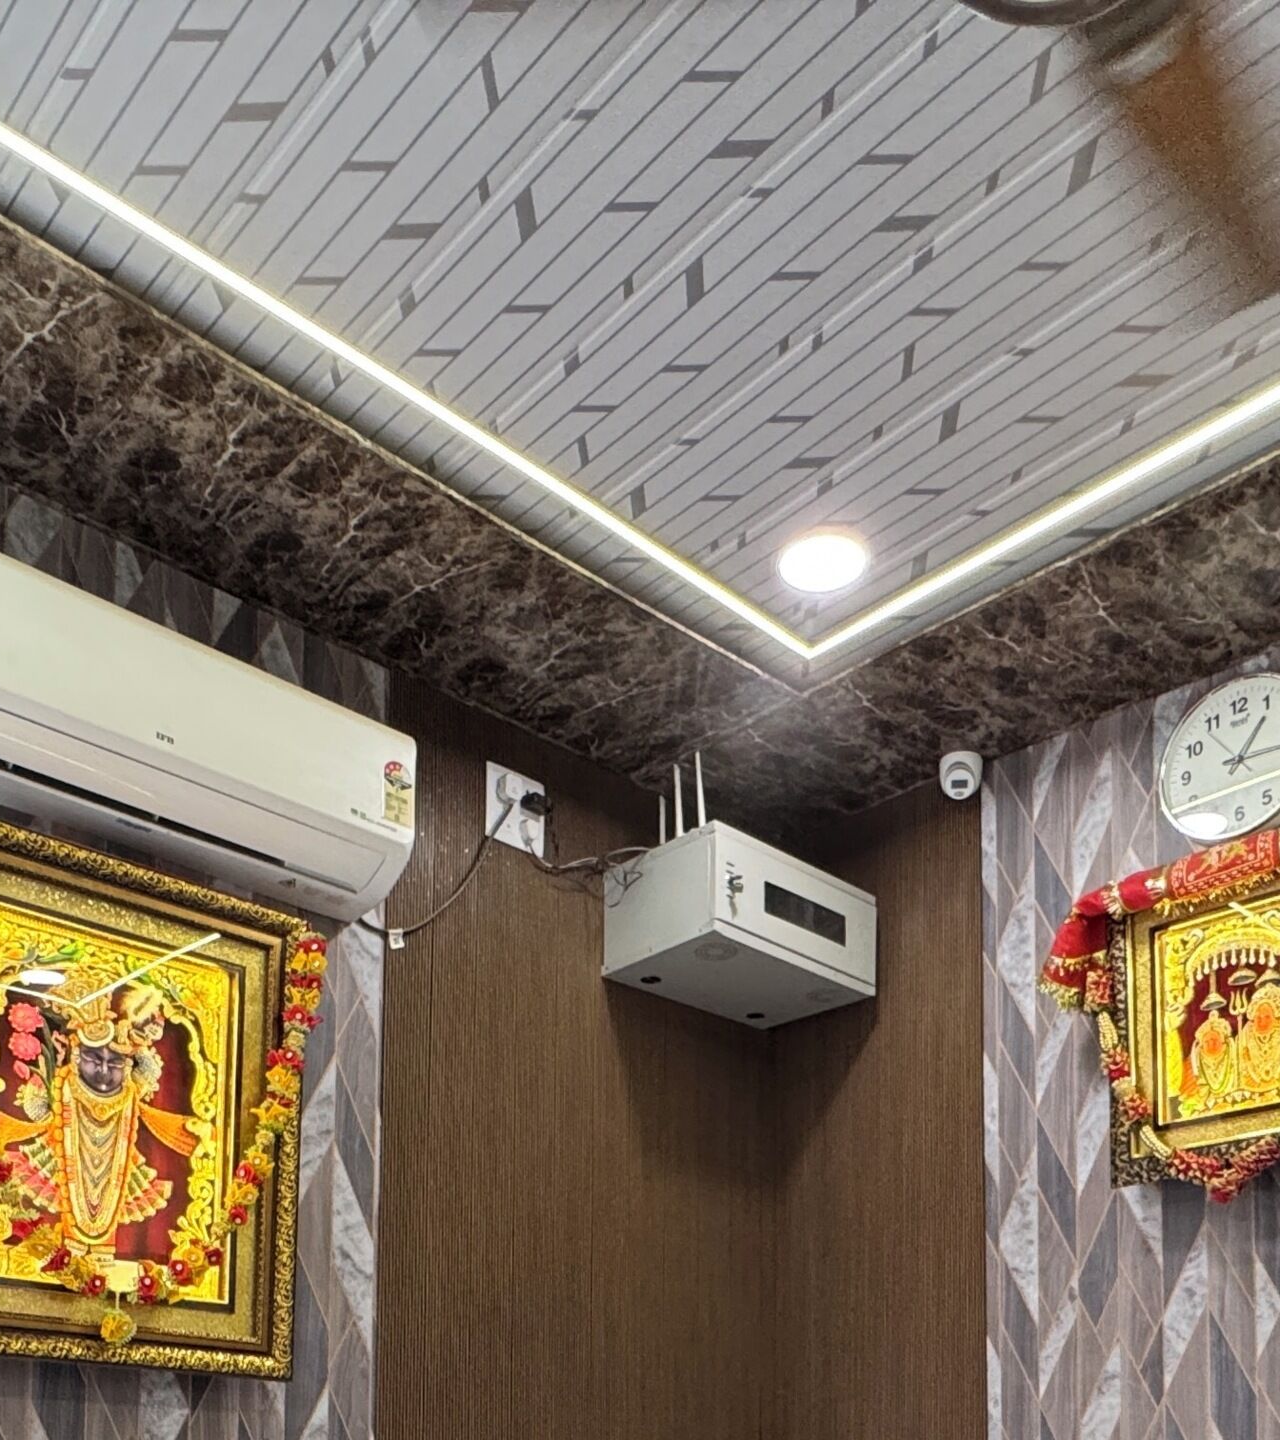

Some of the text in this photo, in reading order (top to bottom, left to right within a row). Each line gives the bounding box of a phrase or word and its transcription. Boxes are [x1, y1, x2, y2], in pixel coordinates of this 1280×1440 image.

[1230, 697, 1248, 715] 12
[1262, 695, 1270, 710] 1
[1205, 714, 1220, 732] 11
[1186, 741, 1203, 758] 10
[1181, 771, 1191, 786] 9
[1262, 789, 1272, 804] 5
[1234, 806, 1245, 821] 6
